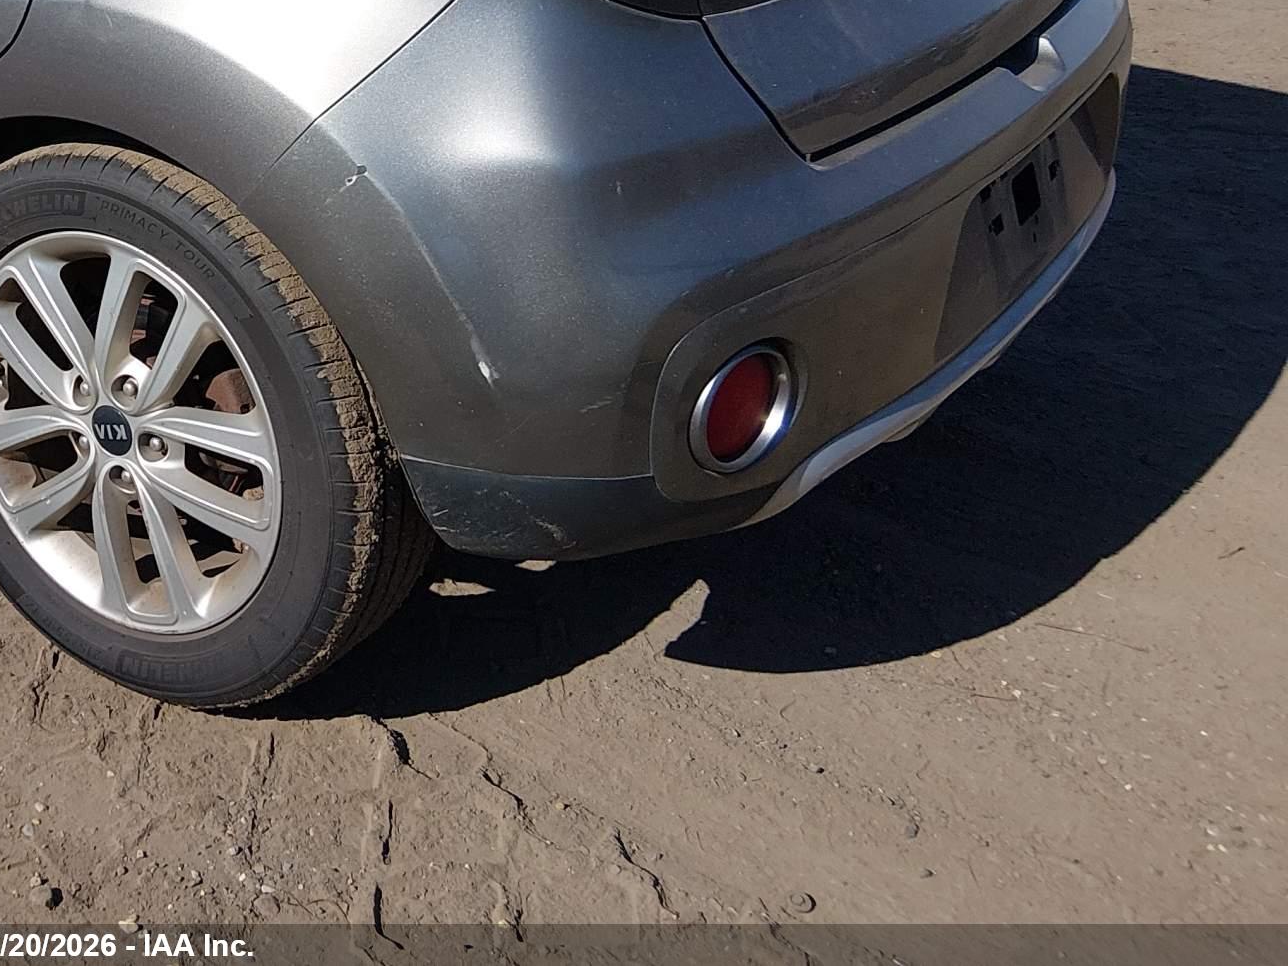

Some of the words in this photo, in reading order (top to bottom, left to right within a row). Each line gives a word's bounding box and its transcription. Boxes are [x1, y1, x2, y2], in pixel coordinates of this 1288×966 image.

[100, 198, 169, 241] PRIMACY
[175, 238, 217, 281] TOUR
[93, 423, 128, 441] KIA
